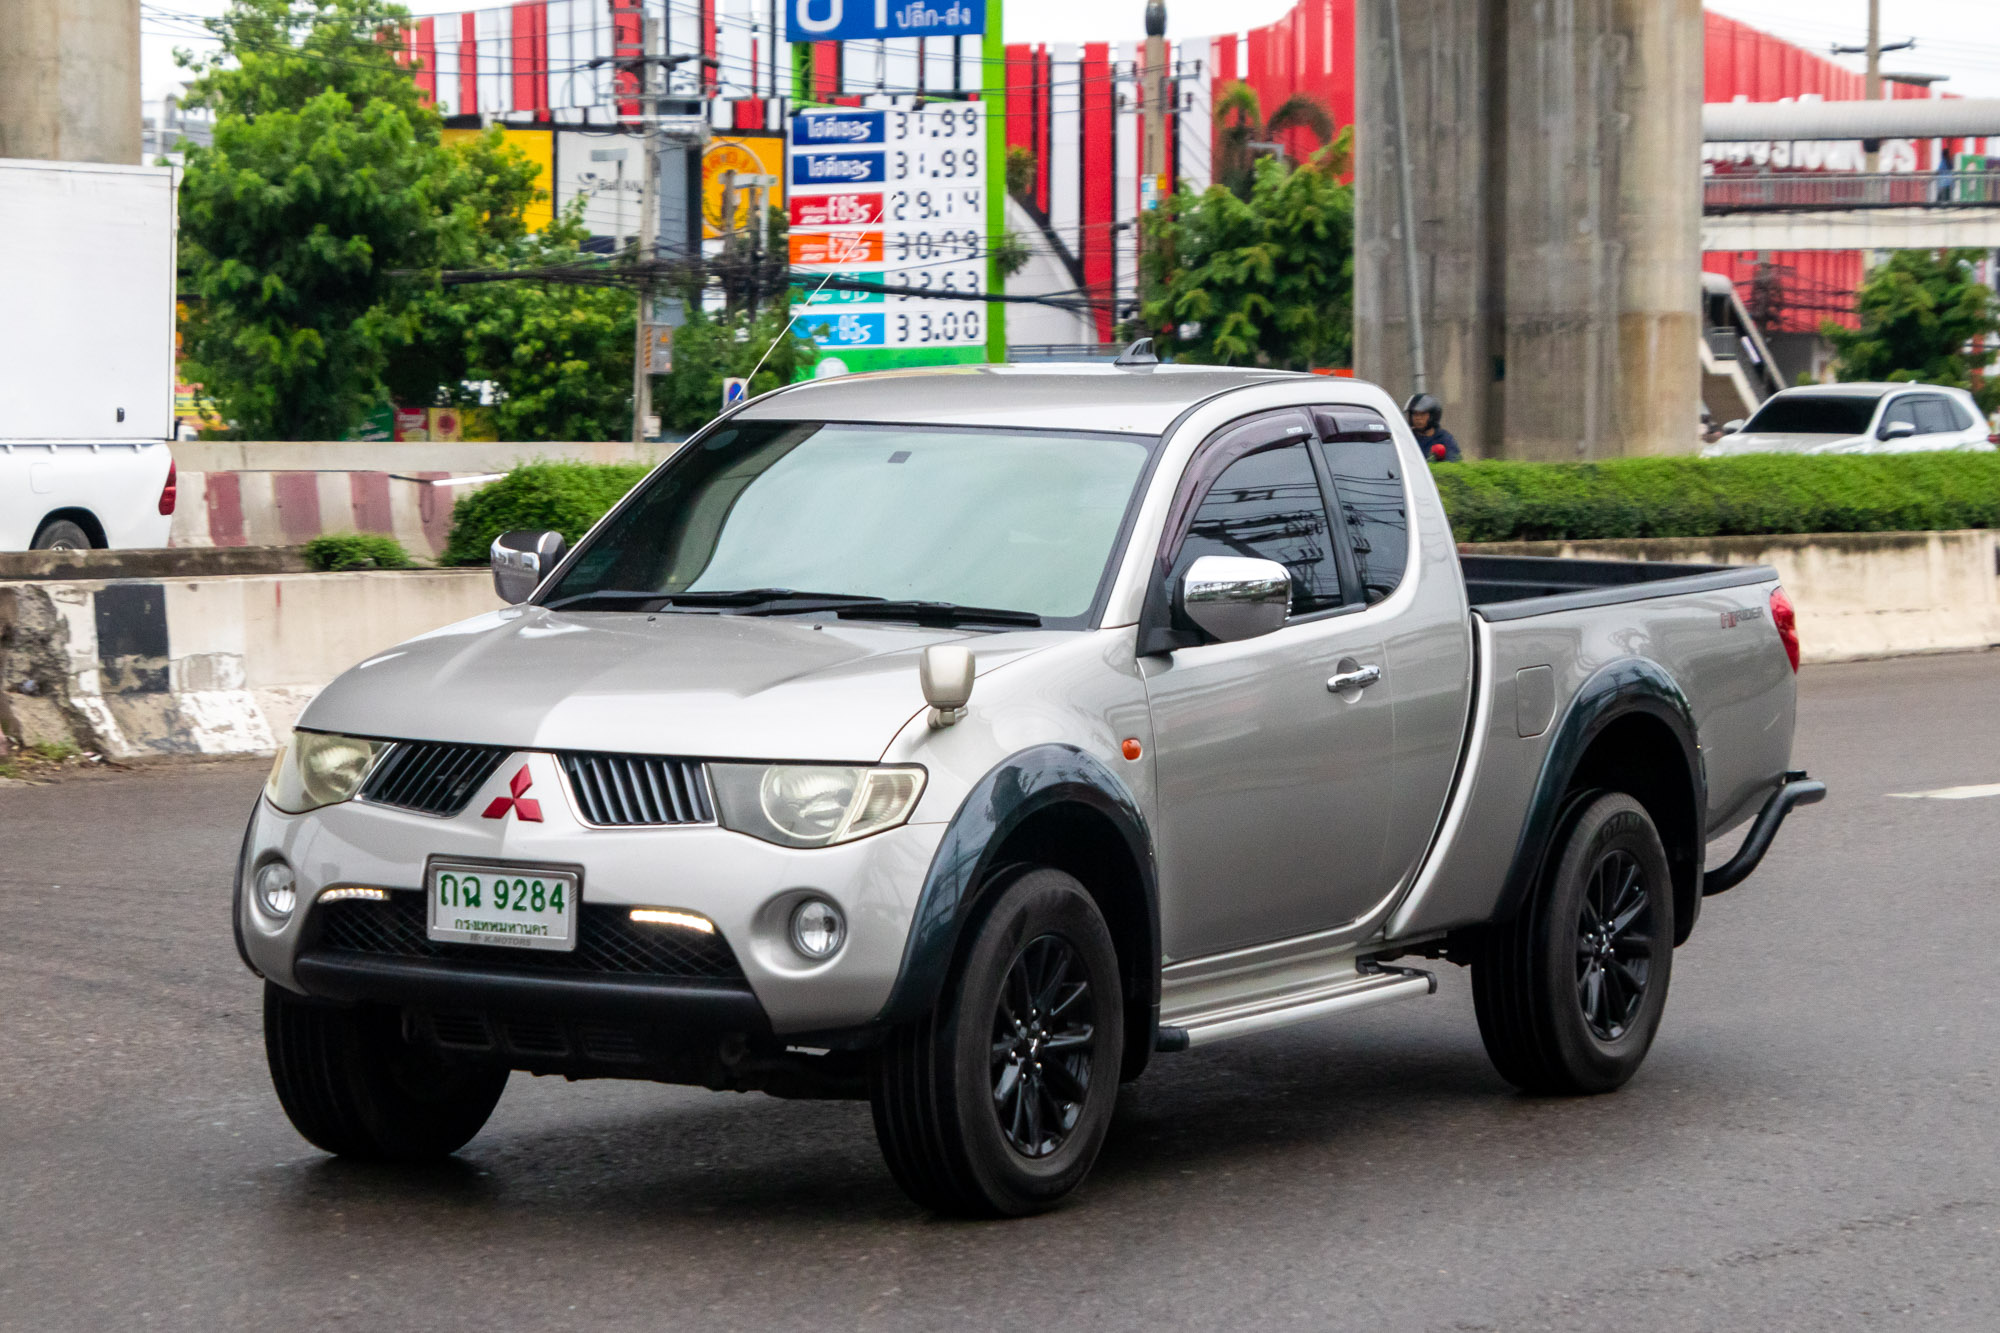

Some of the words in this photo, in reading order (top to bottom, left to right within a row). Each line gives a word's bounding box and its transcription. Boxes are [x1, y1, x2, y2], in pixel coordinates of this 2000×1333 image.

[896, 108, 977, 140] 31.99
[896, 149, 978, 180] 31.99
[894, 191, 979, 221] 29.14
[897, 310, 979, 342] 33.00
[493, 879, 565, 914] 9284
